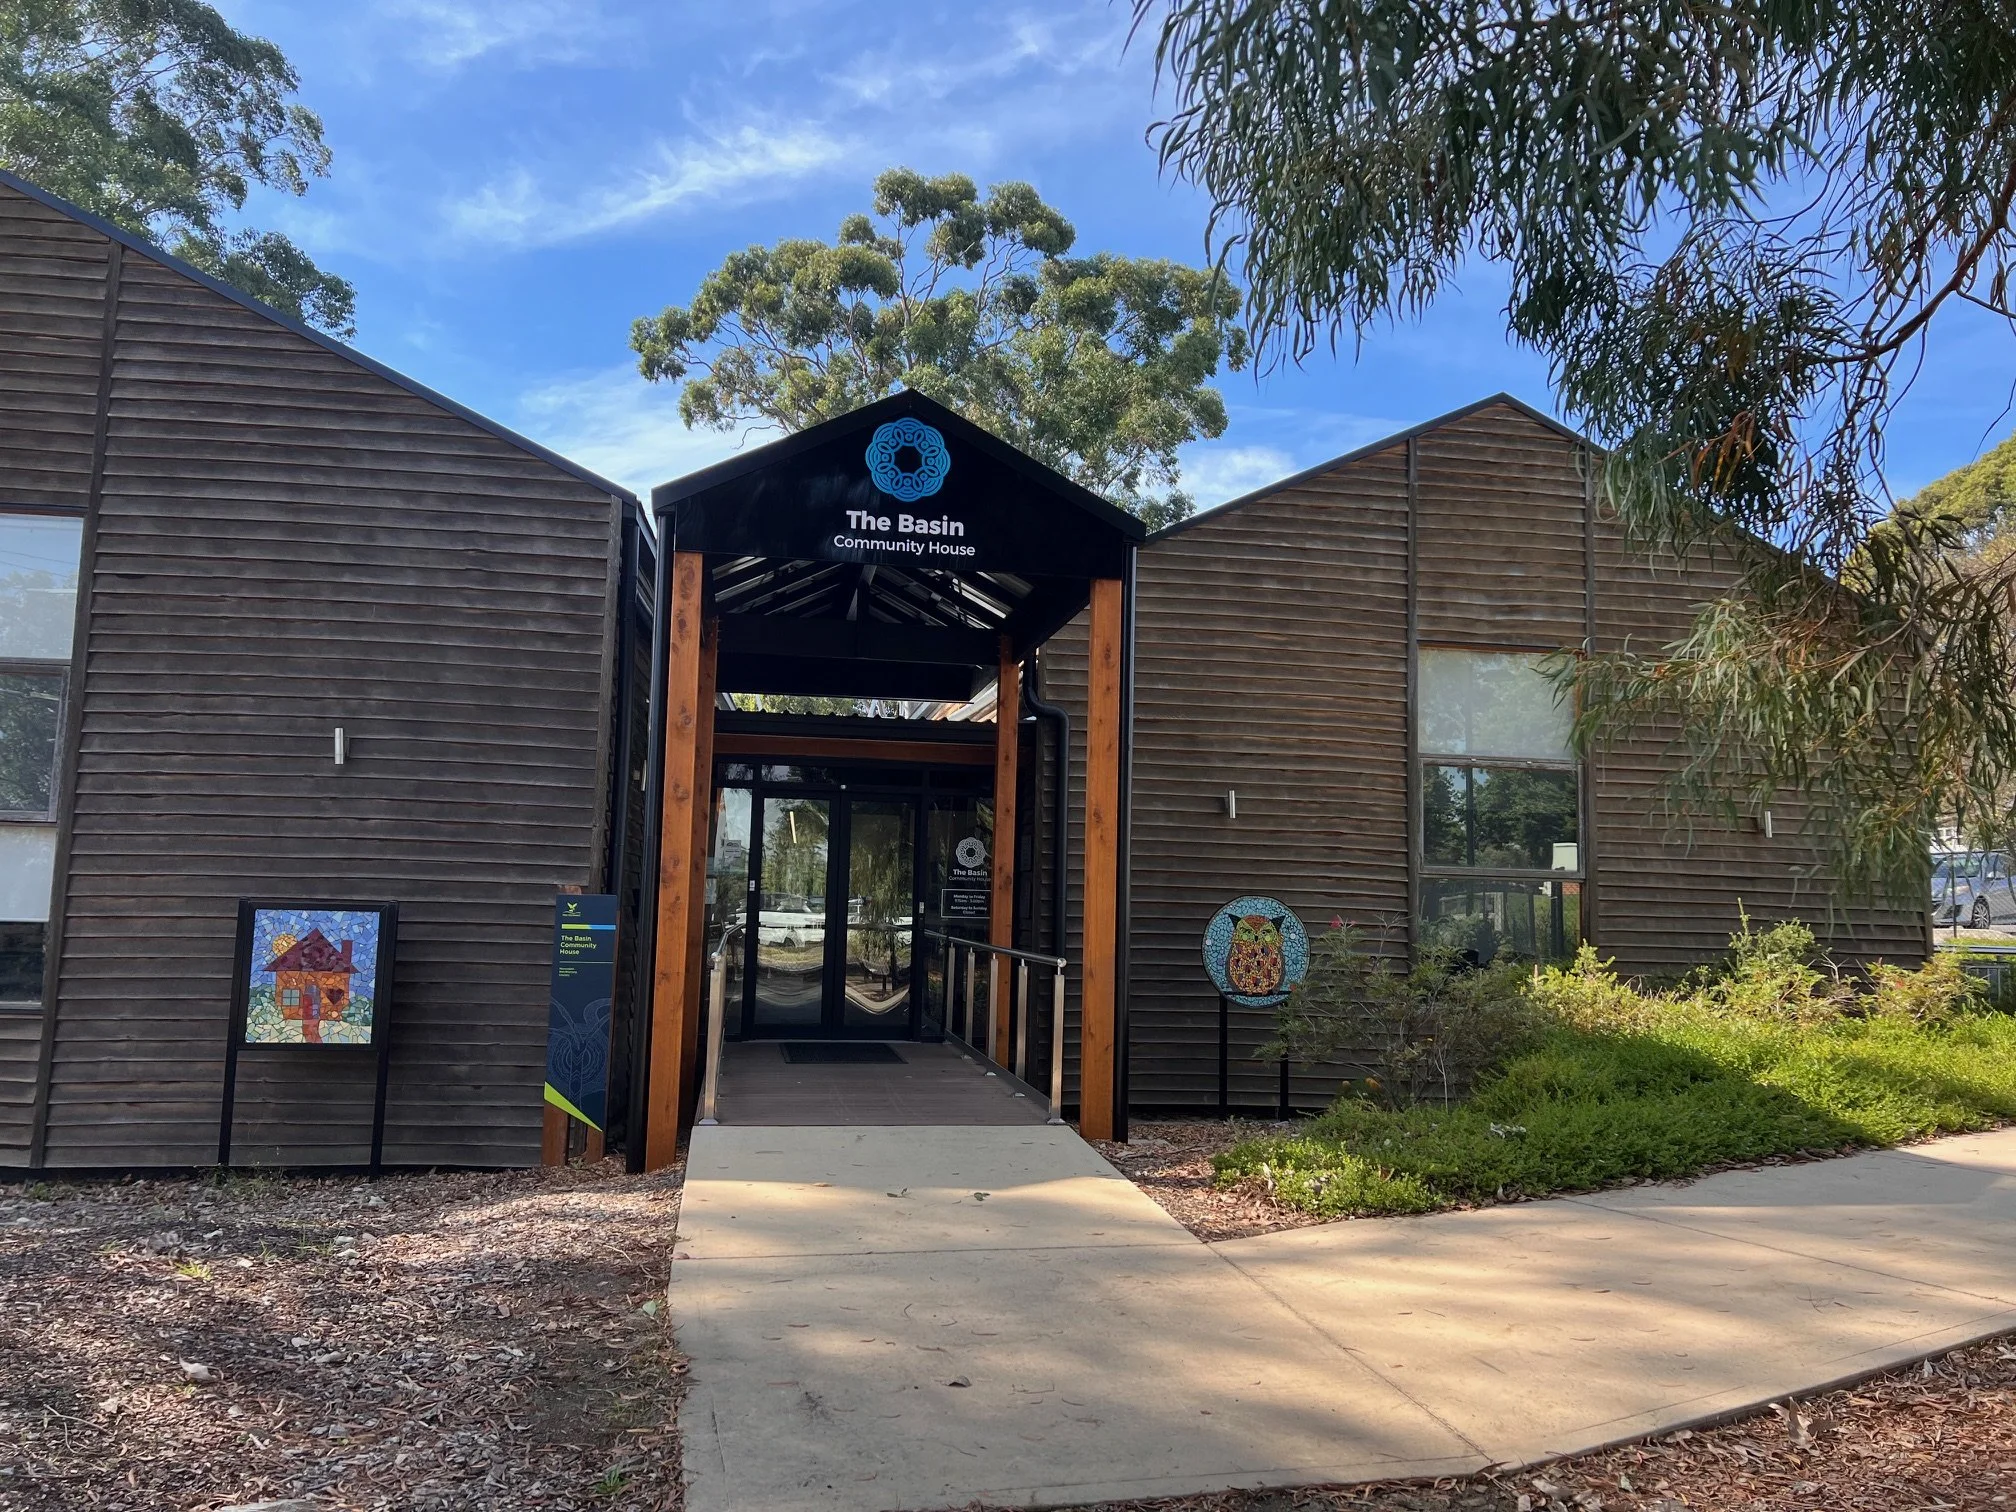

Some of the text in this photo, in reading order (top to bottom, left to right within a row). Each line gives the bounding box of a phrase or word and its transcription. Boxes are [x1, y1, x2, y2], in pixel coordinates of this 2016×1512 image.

[846, 510, 964, 536] The Basin
[833, 535, 976, 556] Community House
